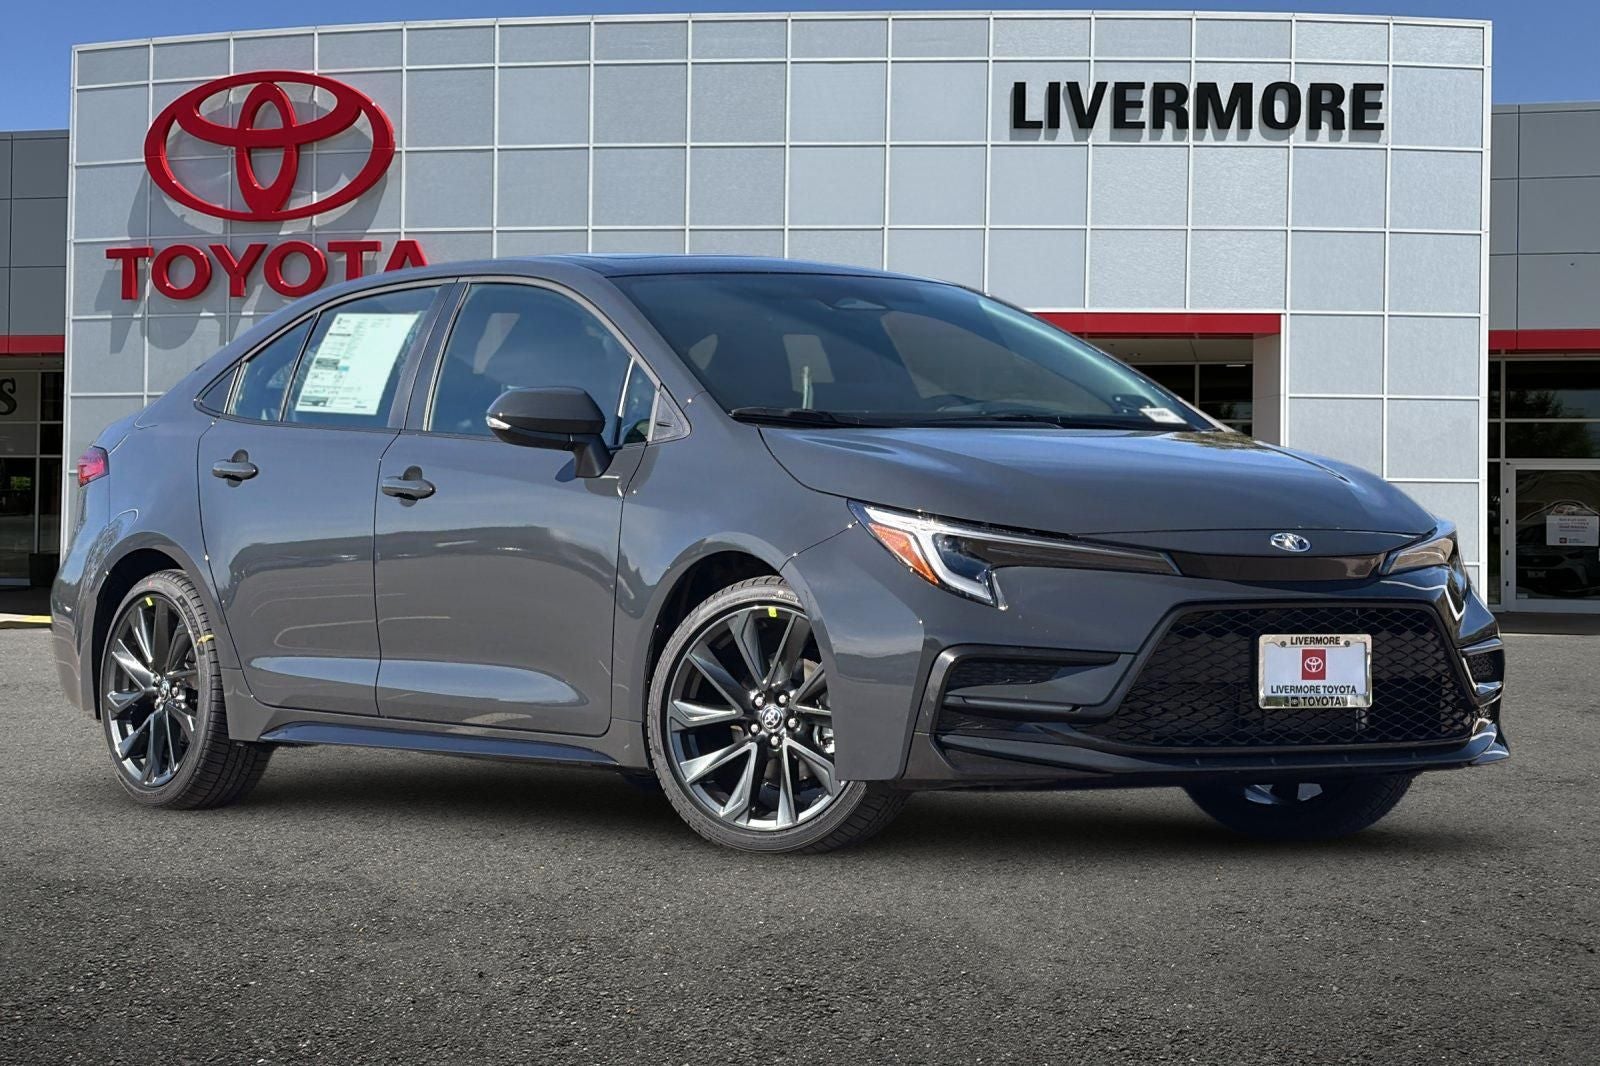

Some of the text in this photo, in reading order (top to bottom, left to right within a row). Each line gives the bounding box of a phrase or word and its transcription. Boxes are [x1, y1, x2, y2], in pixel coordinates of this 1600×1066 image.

[1013, 81, 1384, 131] LIVERMORE
[1290, 636, 1341, 646] LIVERMORE
[1270, 685, 1357, 694] LIVERMORE TOYOTA
[1302, 696, 1342, 707] TOYOTA
